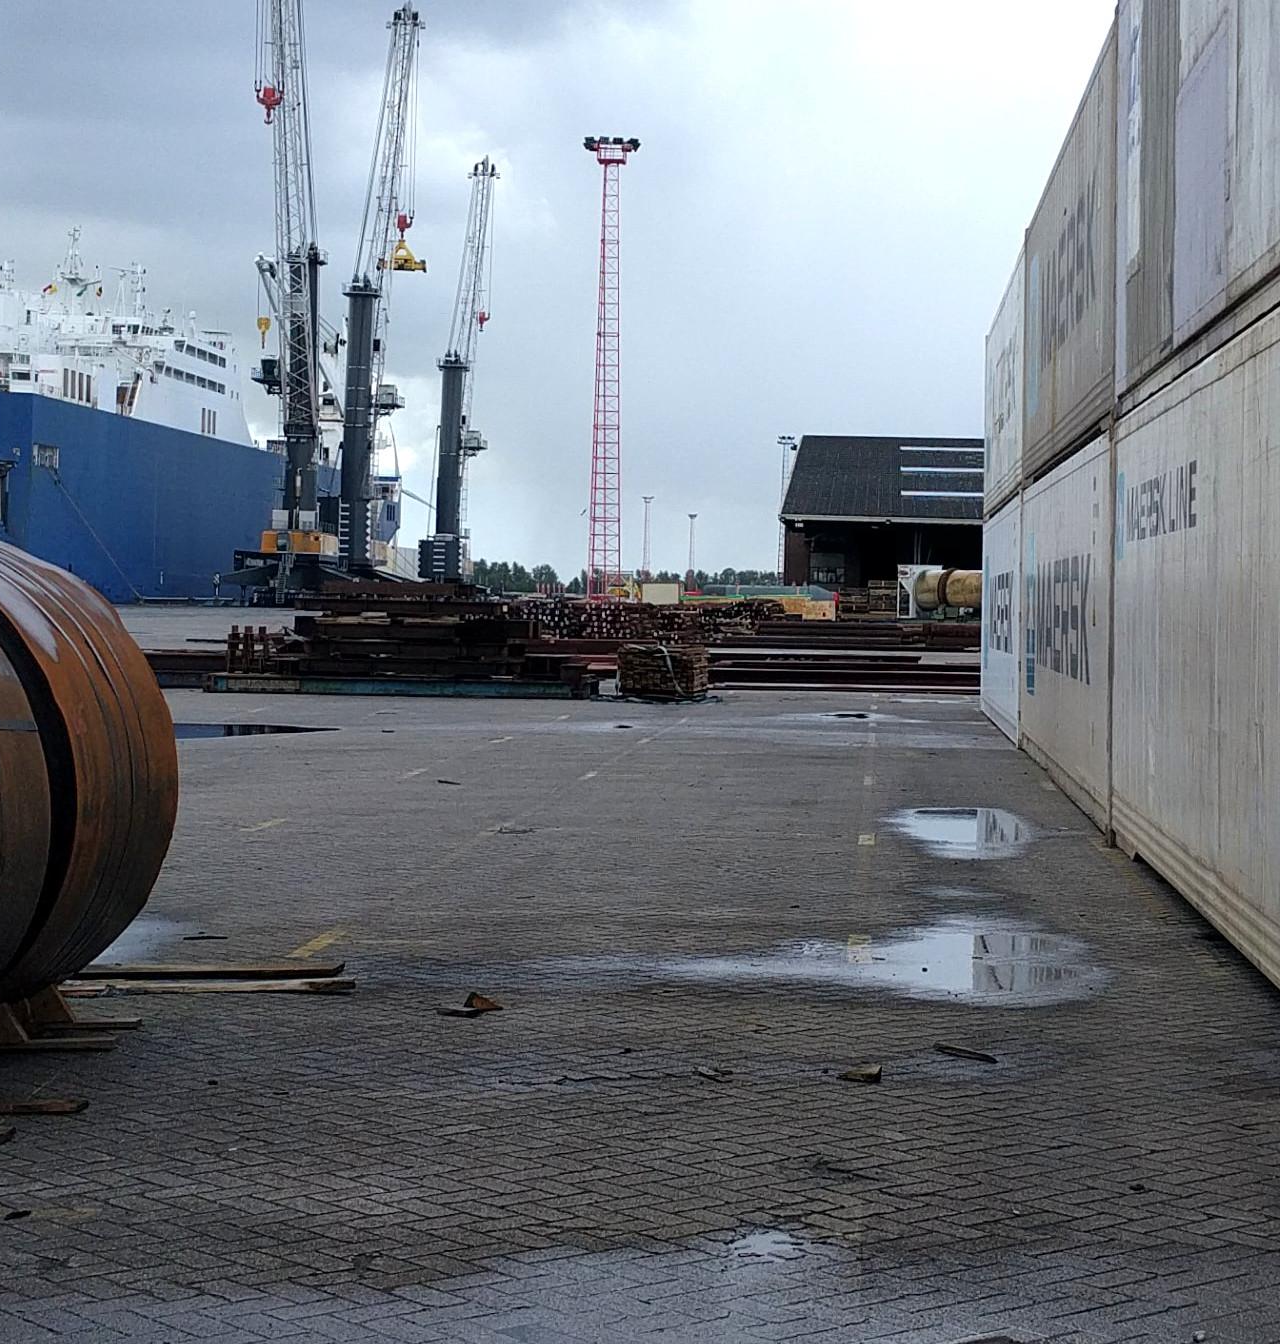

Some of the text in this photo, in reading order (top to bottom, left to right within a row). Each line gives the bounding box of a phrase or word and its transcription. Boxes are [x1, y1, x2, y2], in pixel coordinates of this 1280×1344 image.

[1040, 170, 1096, 371] MAERSK
[1127, 473, 1166, 542] MAERSK
[1168, 459, 1197, 533] LINE
[1036, 553, 1091, 685] MAERSK
